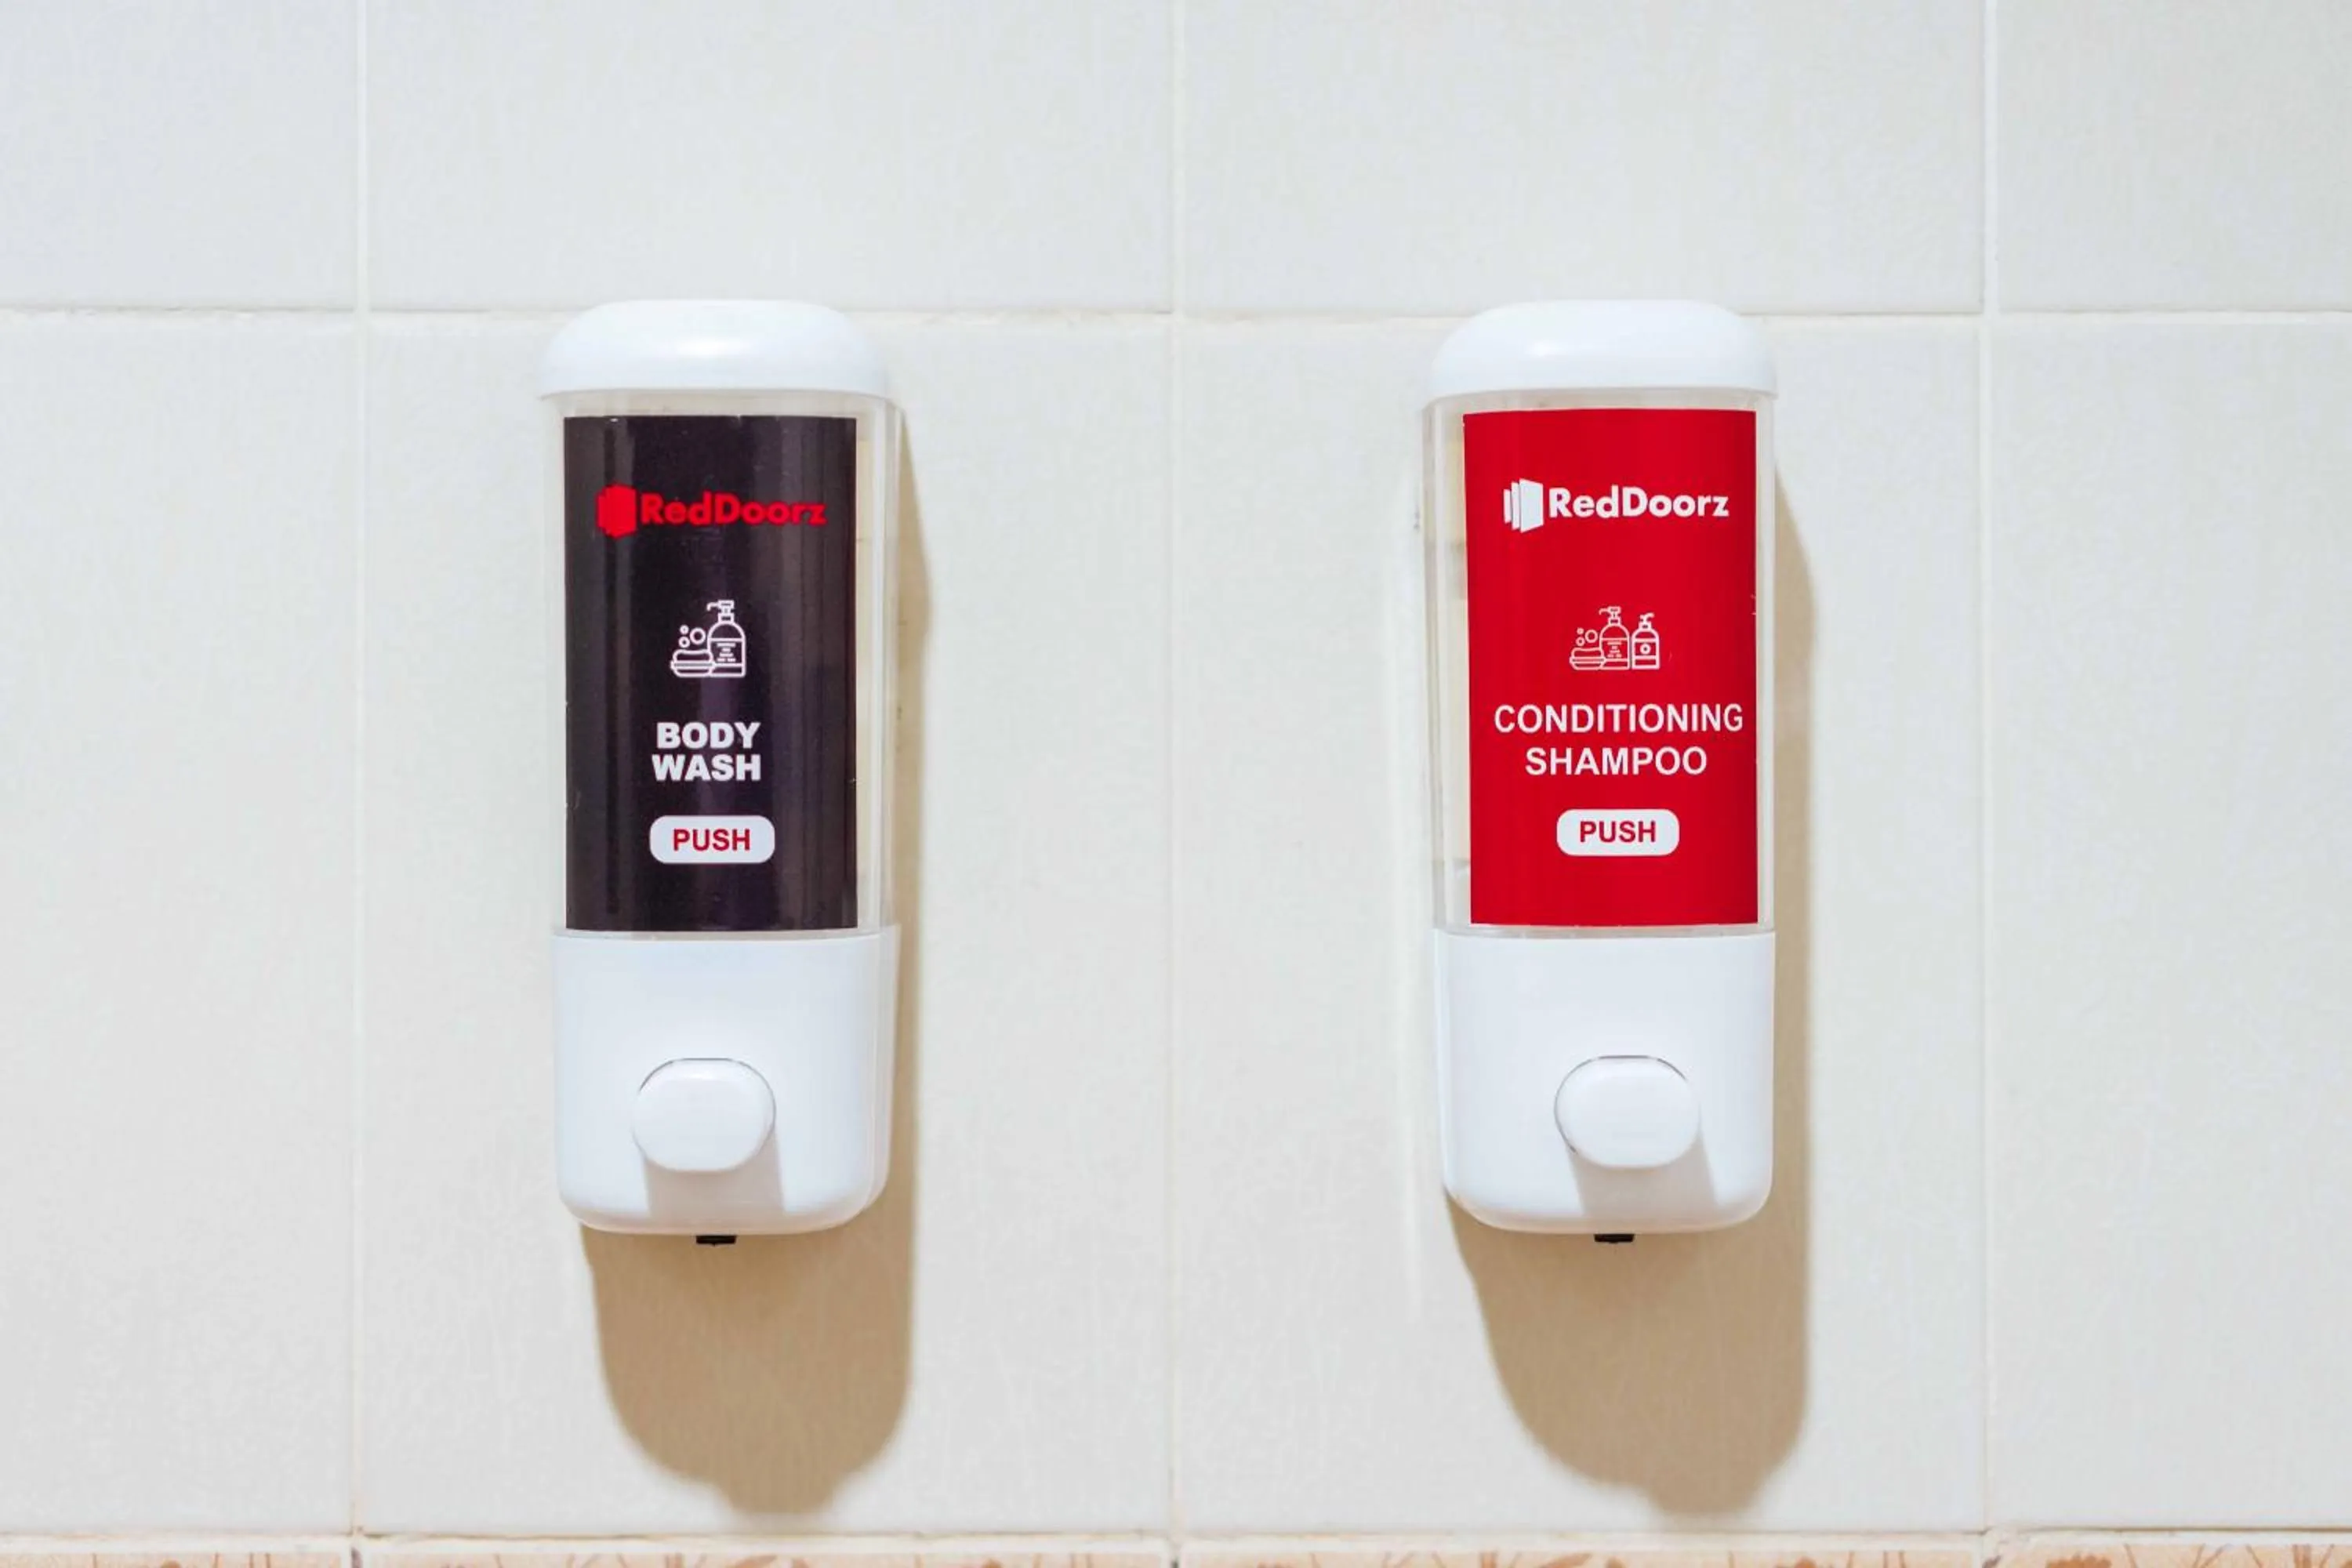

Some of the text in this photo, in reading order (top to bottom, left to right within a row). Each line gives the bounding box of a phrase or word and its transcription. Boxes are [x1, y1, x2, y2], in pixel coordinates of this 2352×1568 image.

[641, 491, 827, 525] RedDoorz
[1548, 485, 1730, 518] RedDoorz
[1494, 703, 1744, 733] CONDITIONING
[656, 722, 761, 750] BODY
[652, 754, 761, 782] WASH
[1525, 746, 1708, 775] SHAMPOO
[673, 828, 750, 851] PUSH
[1580, 820, 1657, 843] PUSH
